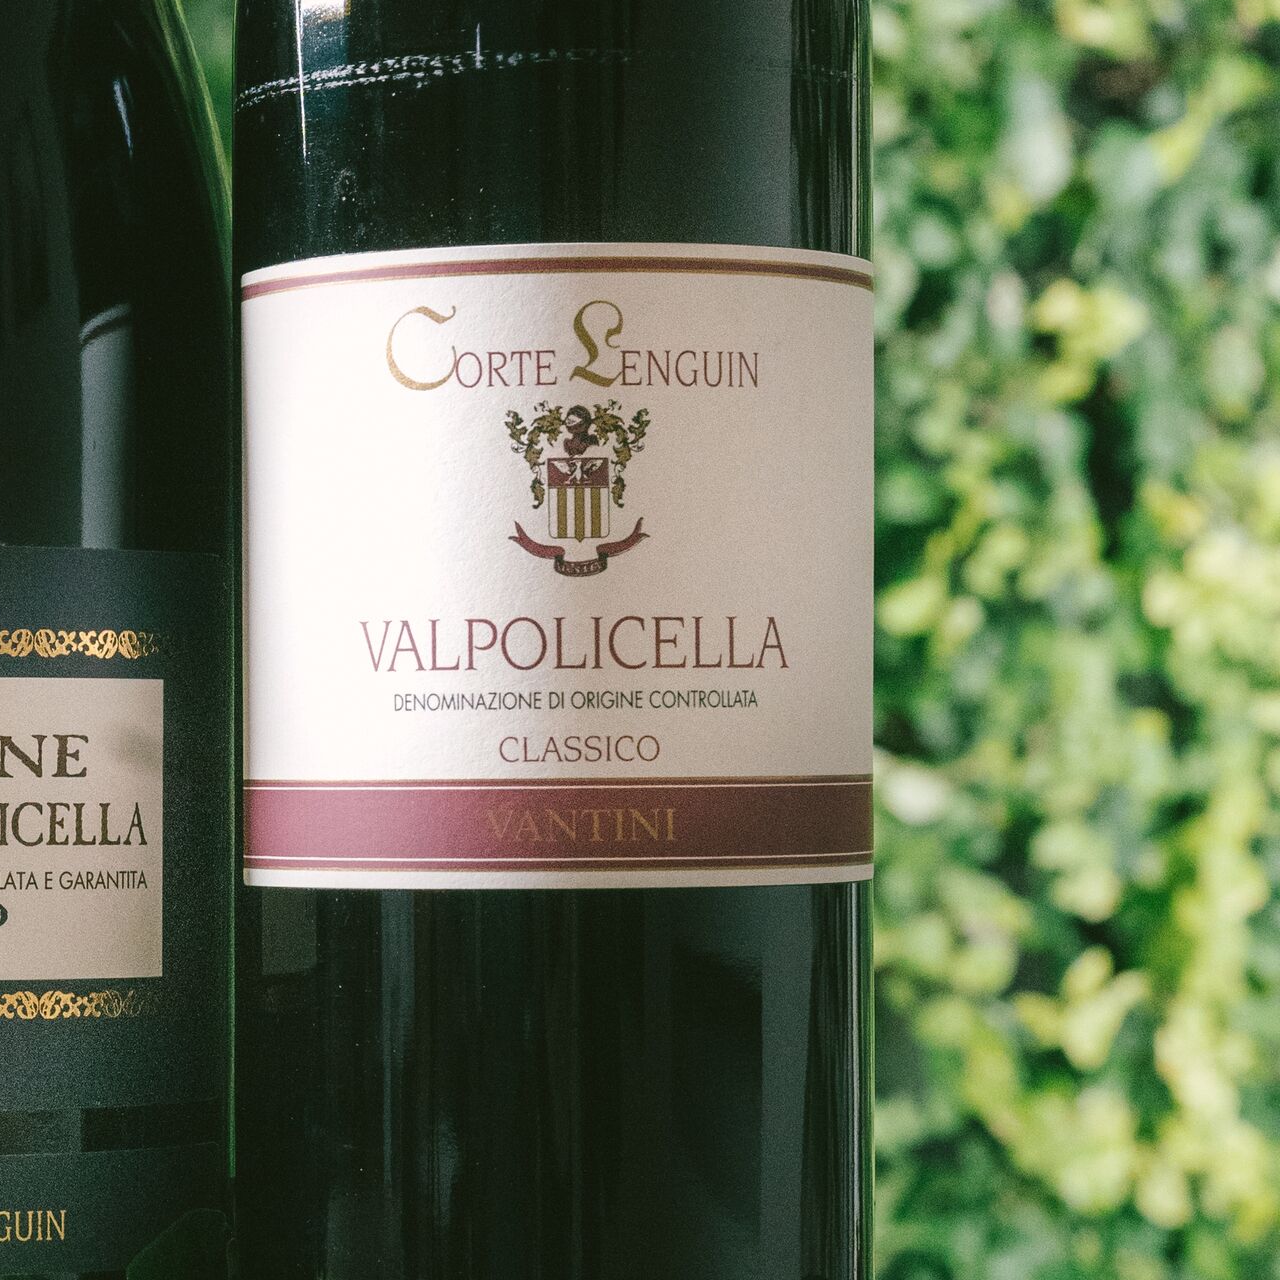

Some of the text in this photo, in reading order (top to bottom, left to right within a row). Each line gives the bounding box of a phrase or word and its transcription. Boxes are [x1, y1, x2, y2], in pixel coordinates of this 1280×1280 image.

[359, 615, 790, 673] VALPOLICELLA
[393, 689, 759, 713] DENOMINAZIONE DI ORIGINE CONTROLLATA
[499, 735, 661, 764] CLASSICO
[488, 807, 677, 844] VANTINI
[44, 871, 54, 890] E
[58, 869, 148, 890] GARANTITA
